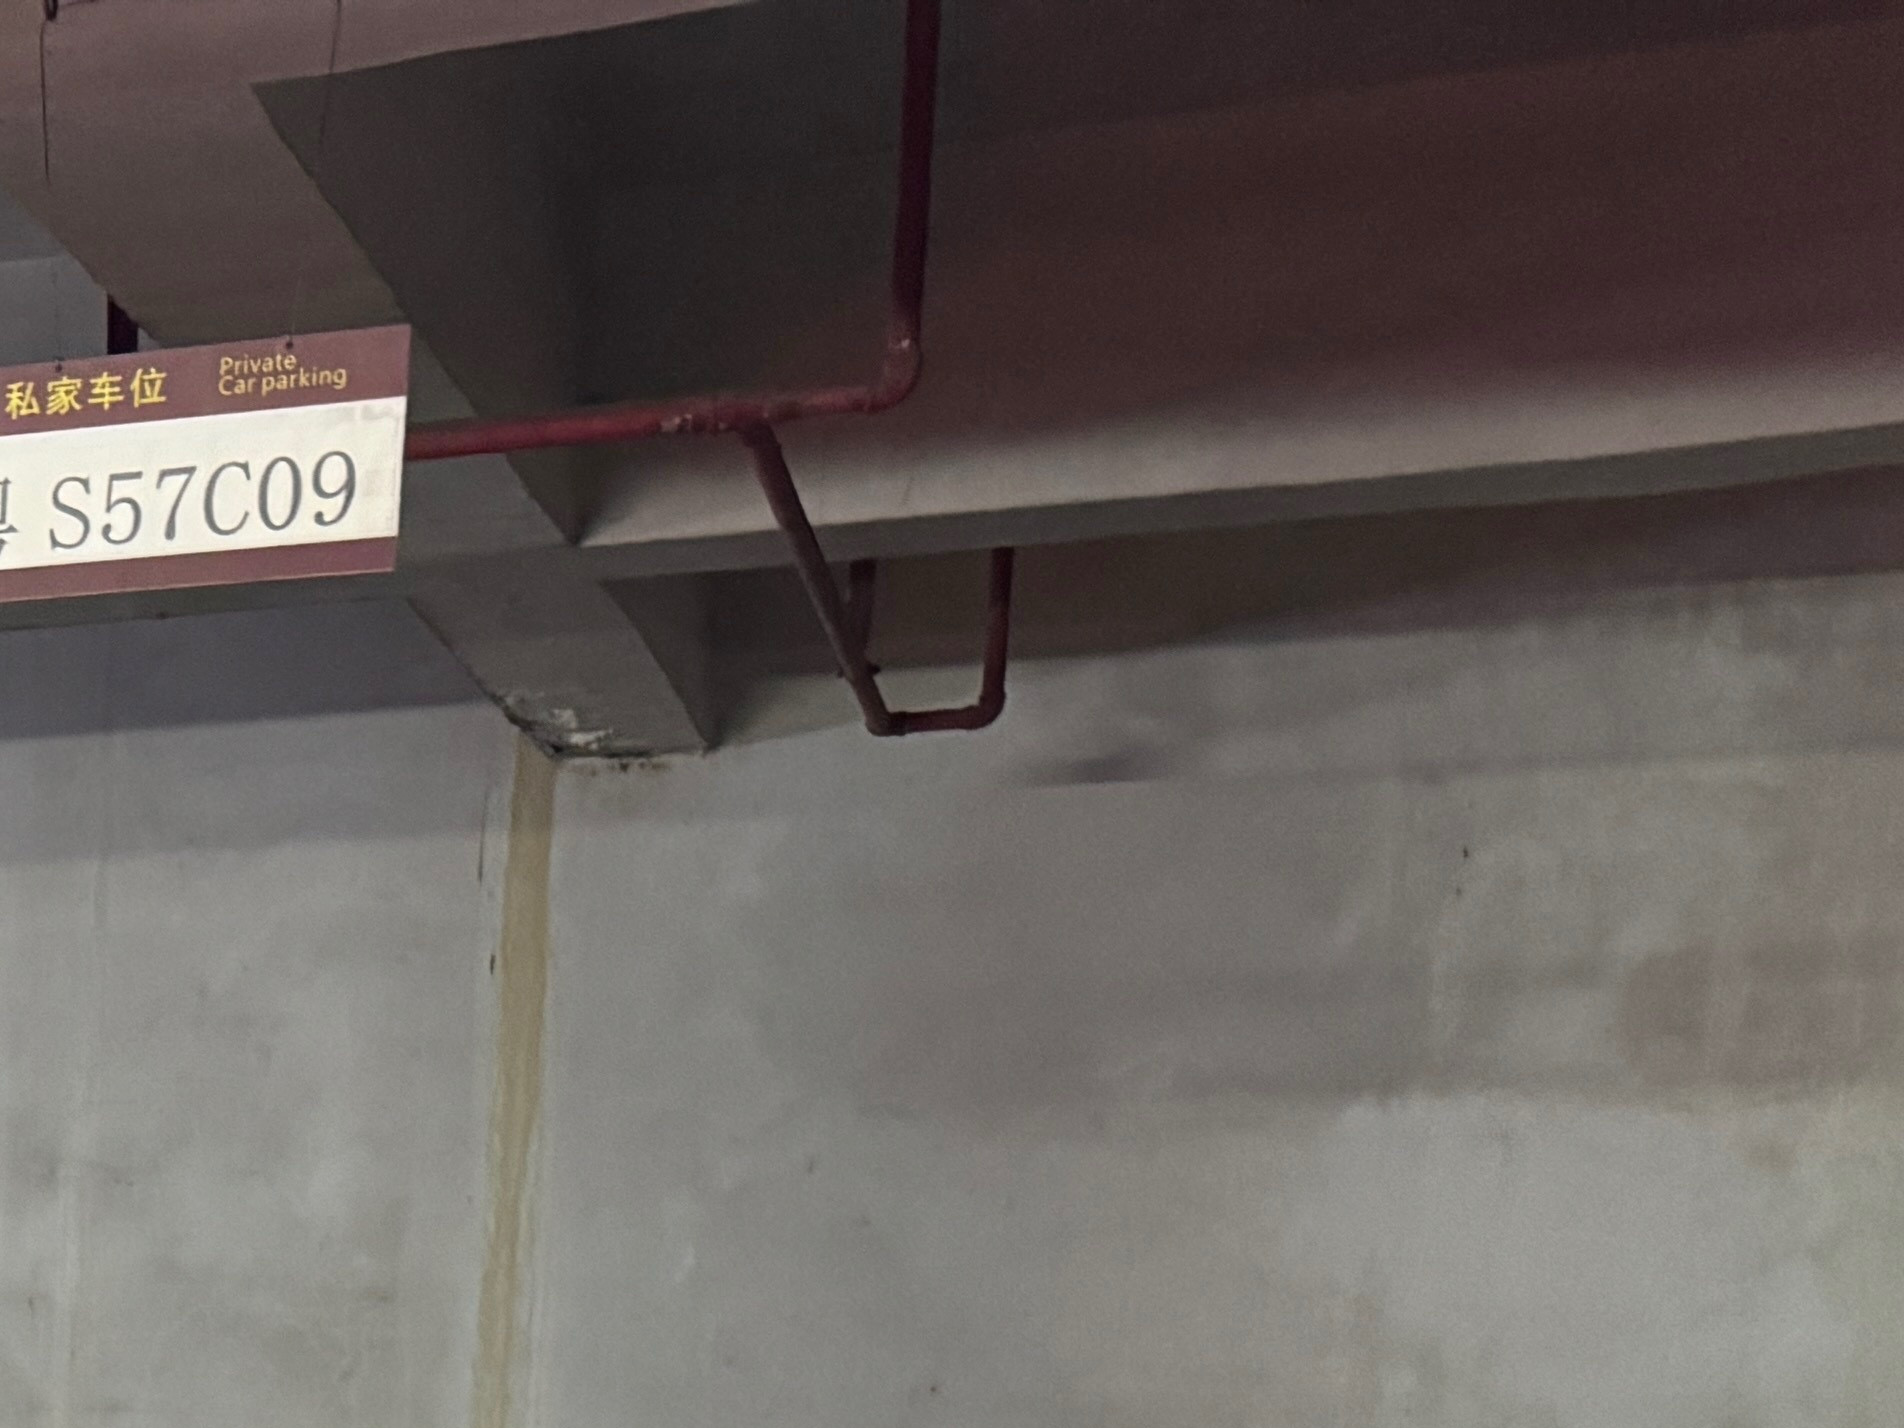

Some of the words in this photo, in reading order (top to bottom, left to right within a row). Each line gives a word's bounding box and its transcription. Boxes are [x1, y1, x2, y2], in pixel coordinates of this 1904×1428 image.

[218, 373, 257, 397] Car
[261, 366, 349, 397] parking
[219, 352, 298, 376] Private
[4, 368, 168, 420] 私家车位
[48, 450, 357, 552] S57C09
